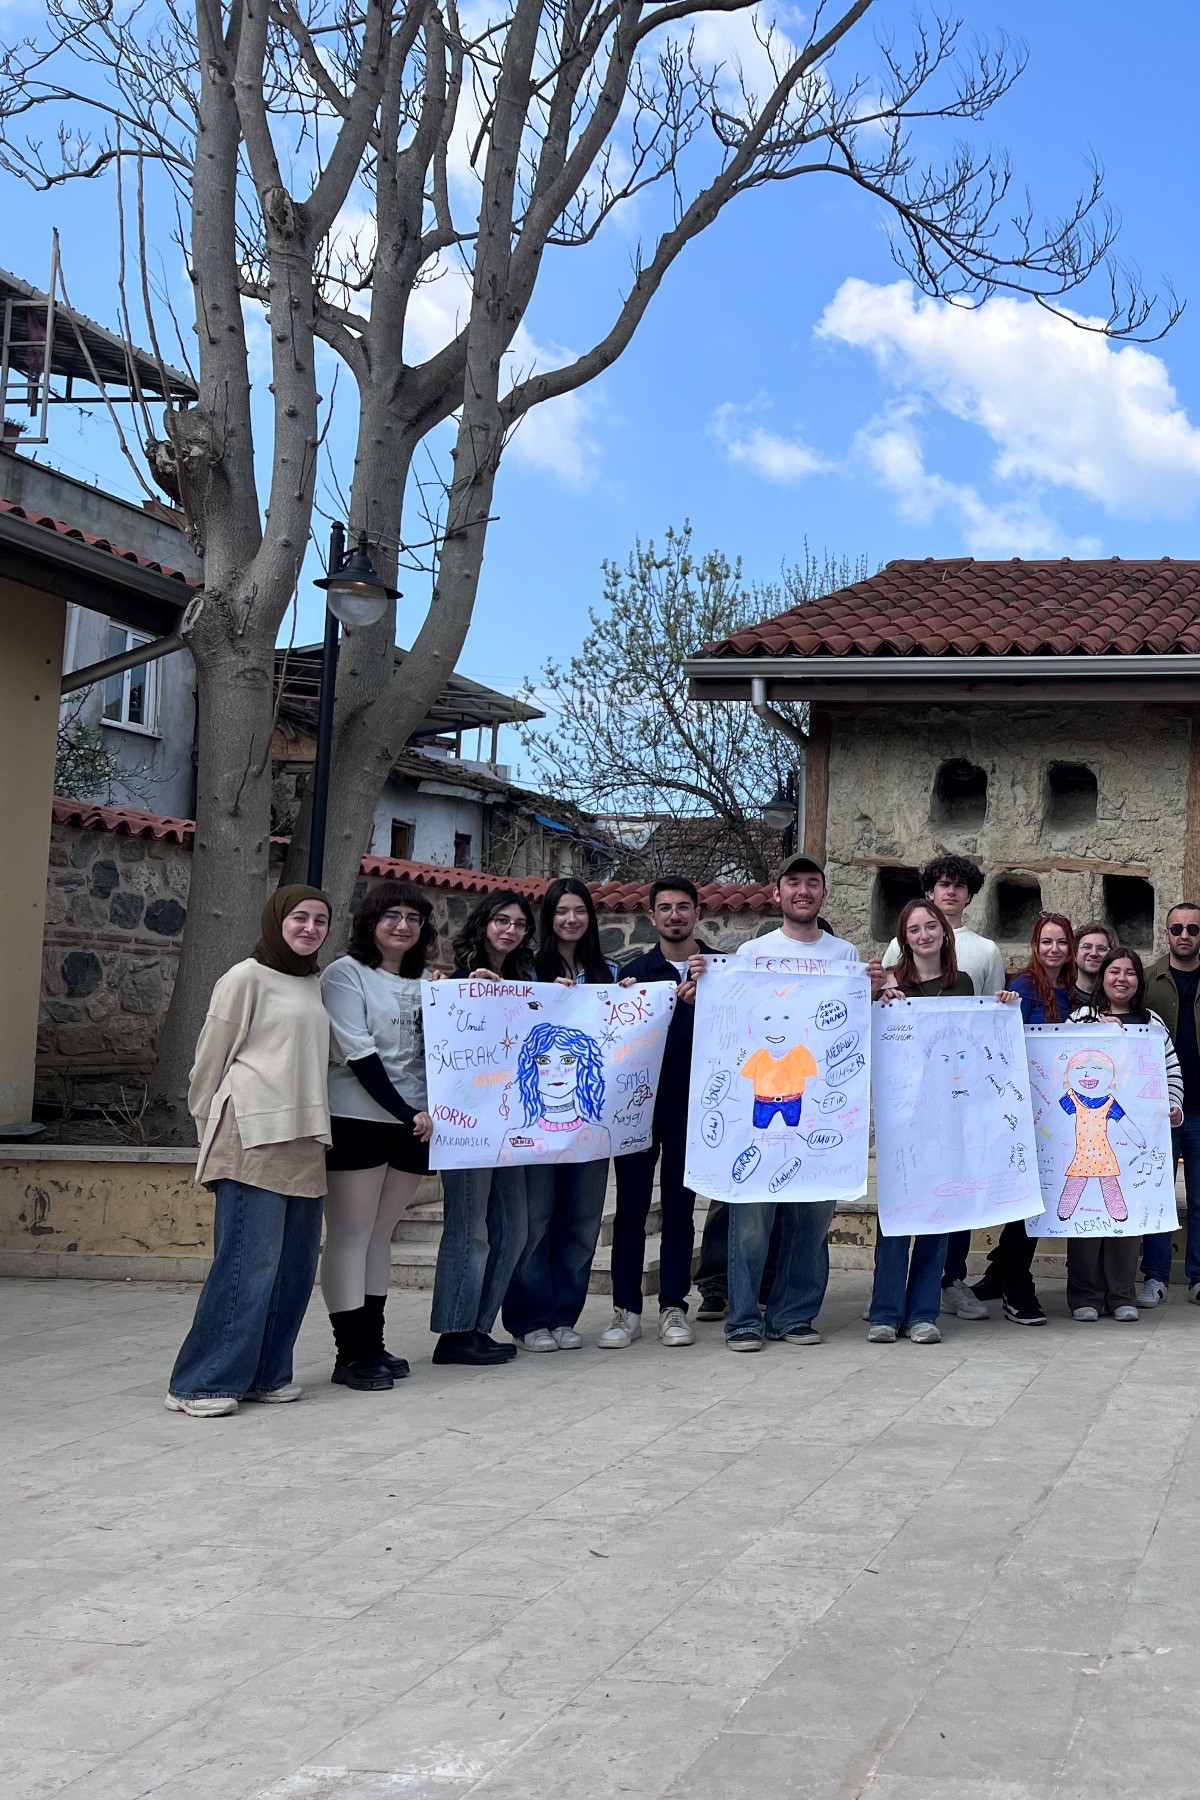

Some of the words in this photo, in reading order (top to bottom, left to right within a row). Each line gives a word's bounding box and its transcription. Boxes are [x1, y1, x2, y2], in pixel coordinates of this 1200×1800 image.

[458, 982, 535, 999] FEDAKARLIK
[437, 1045, 500, 1075] MERAK
[616, 1067, 650, 1094] SAYGI
[432, 1104, 478, 1129] KORKU
[810, 1133, 836, 1145] UMUT
